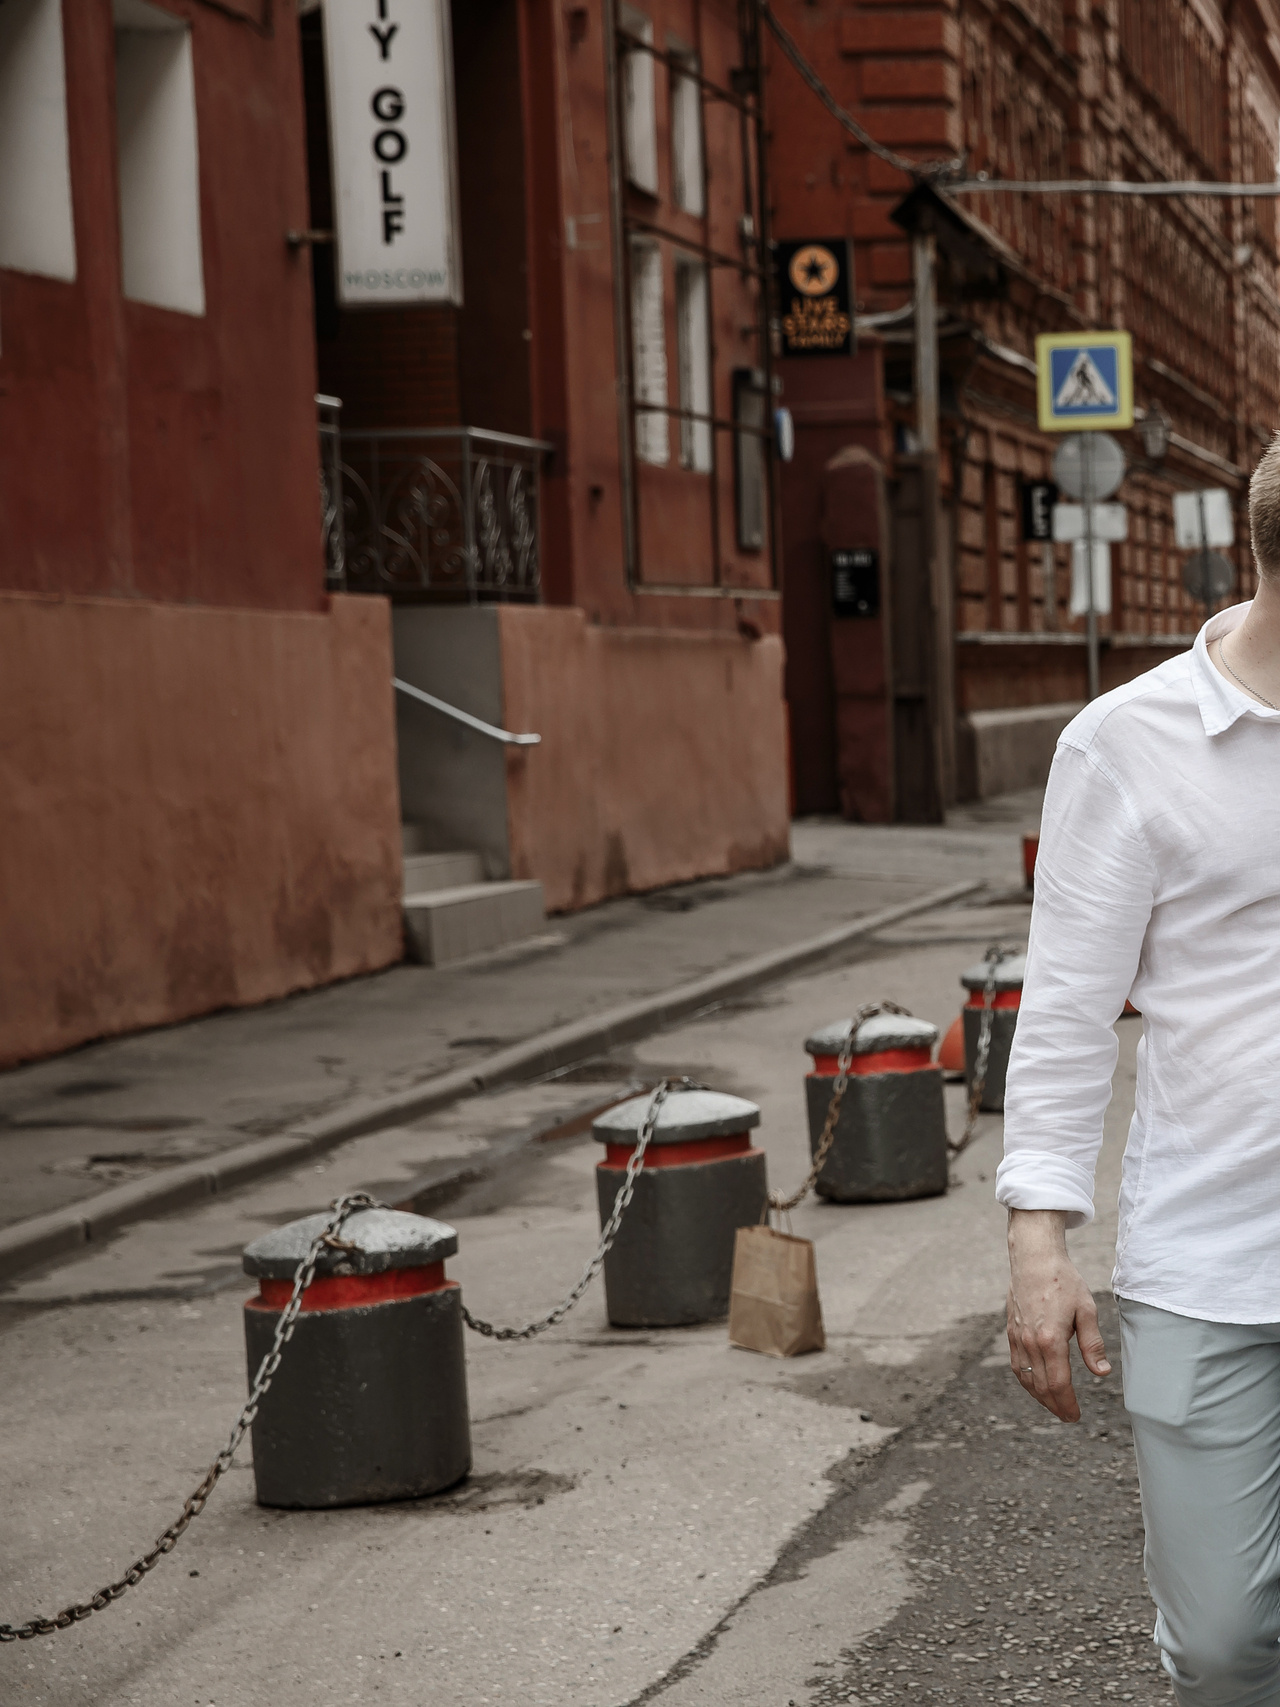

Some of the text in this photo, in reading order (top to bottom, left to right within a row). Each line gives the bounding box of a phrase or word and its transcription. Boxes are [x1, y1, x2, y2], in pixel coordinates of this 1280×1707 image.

[369, 86, 409, 246] GOLF
[344, 268, 446, 290] MOSCOW
[790, 297, 839, 316] LIVE
[782, 314, 851, 335] STARS
